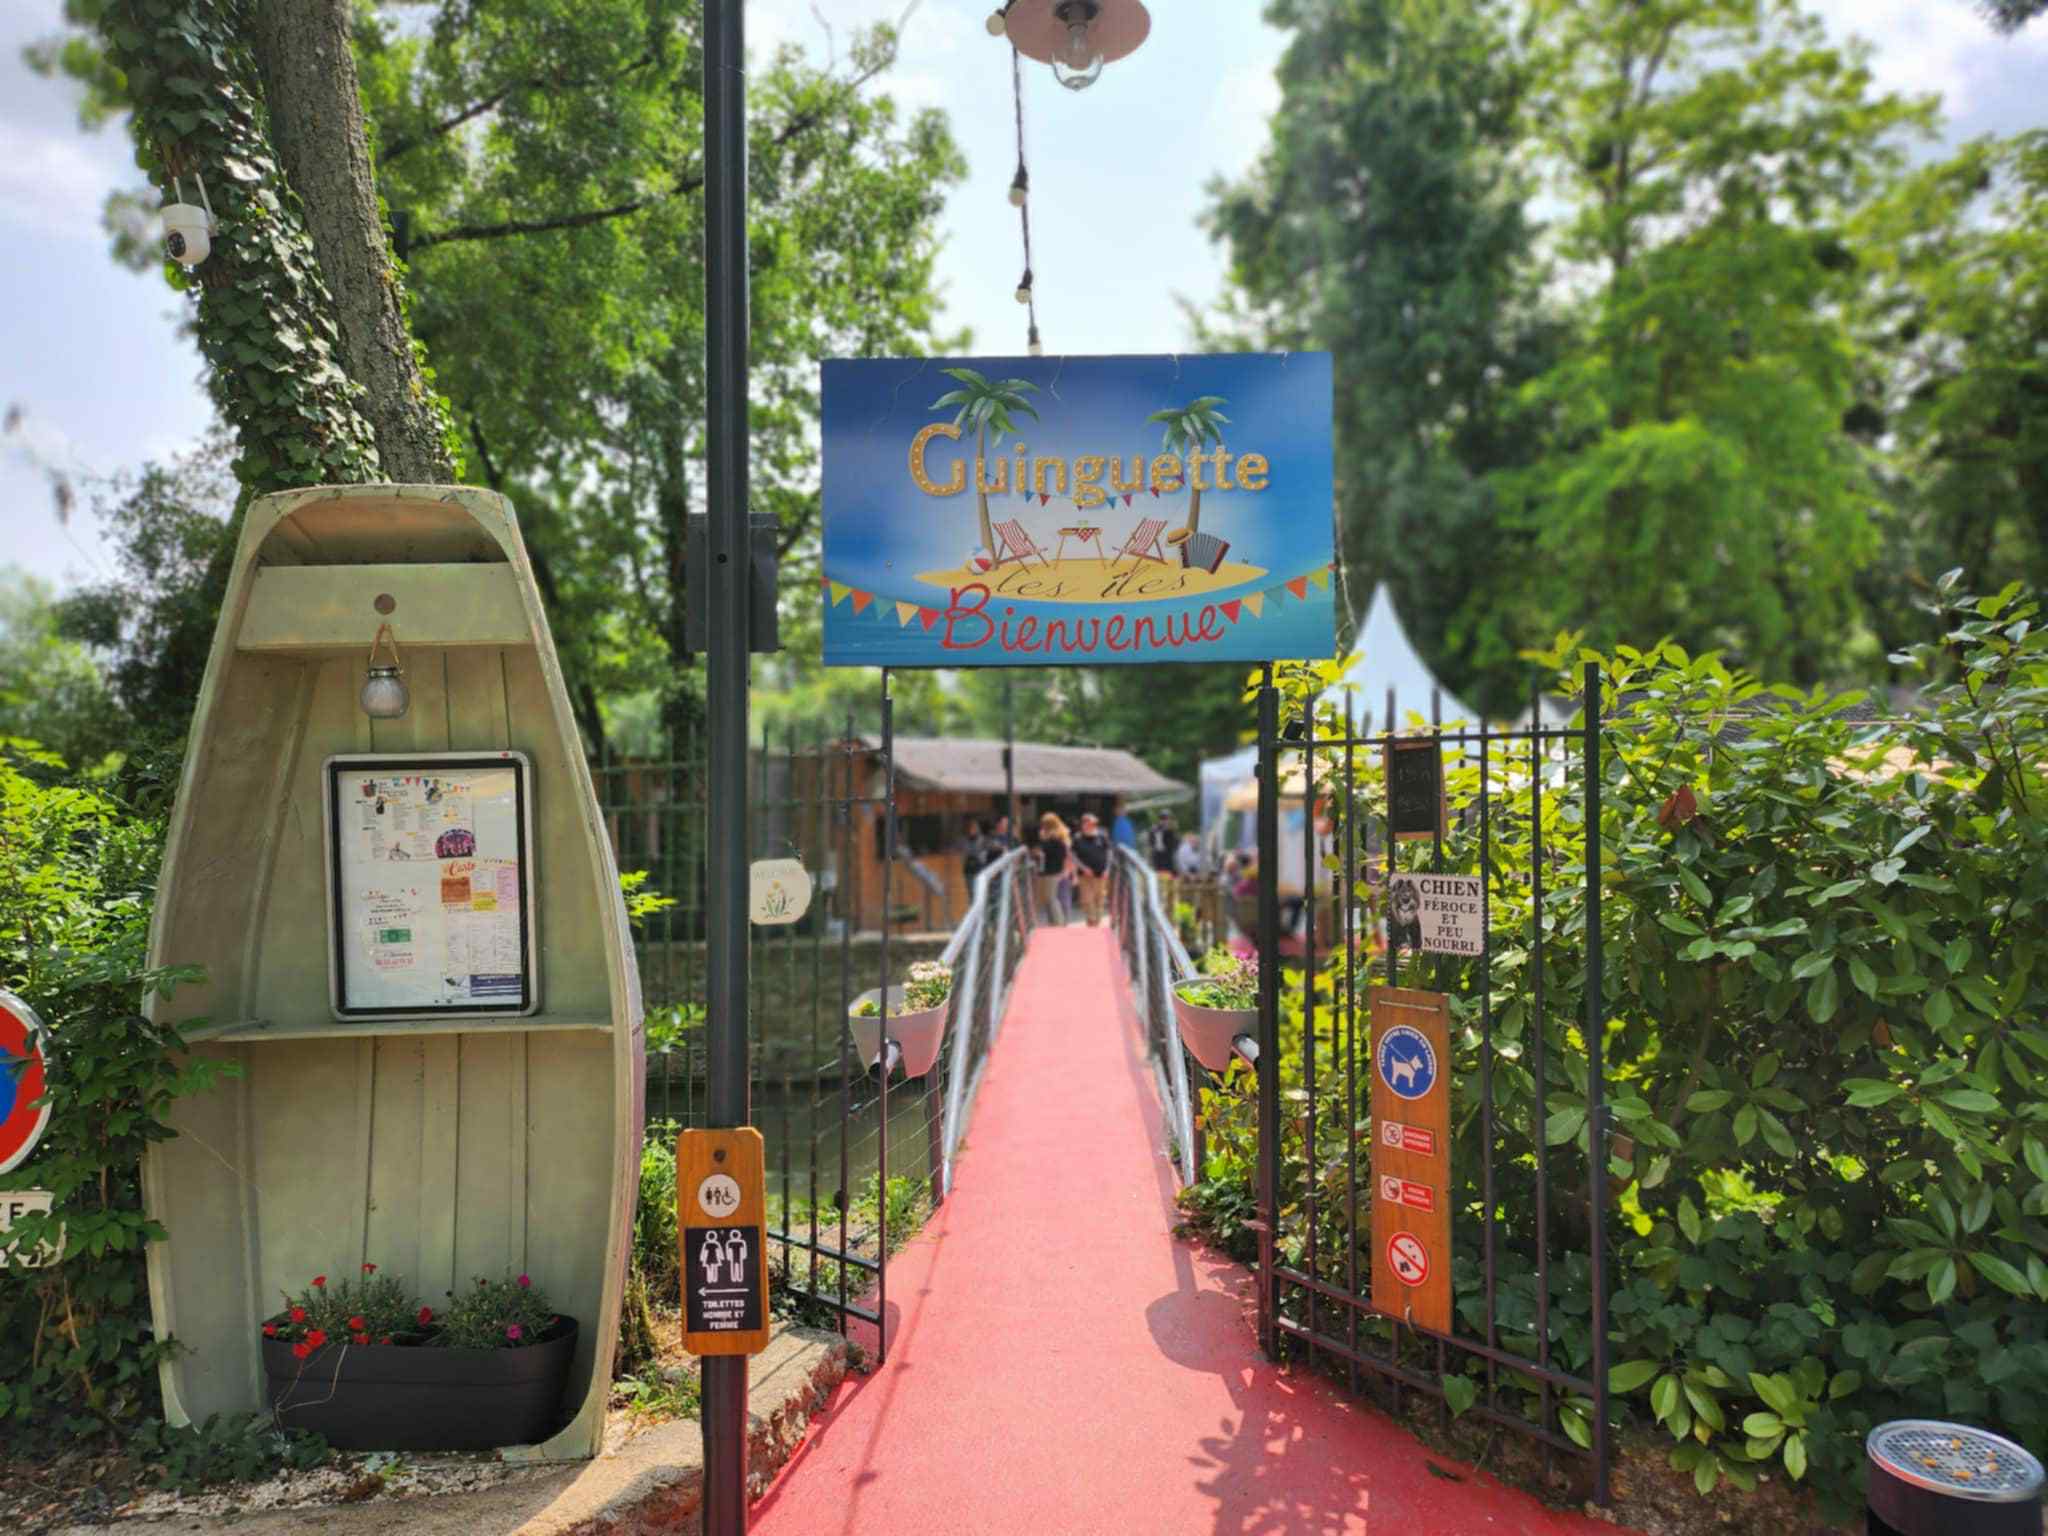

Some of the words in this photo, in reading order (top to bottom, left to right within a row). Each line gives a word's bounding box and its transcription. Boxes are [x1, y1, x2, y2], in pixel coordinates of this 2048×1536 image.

[909, 422, 1270, 508] Guinguette
[941, 583, 1225, 653] Bienvenue
[1420, 879, 1480, 897] CHIEN
[1424, 897, 1477, 914] FÉROCE
[1441, 913, 1458, 925] ET
[1437, 926, 1463, 938] PEU
